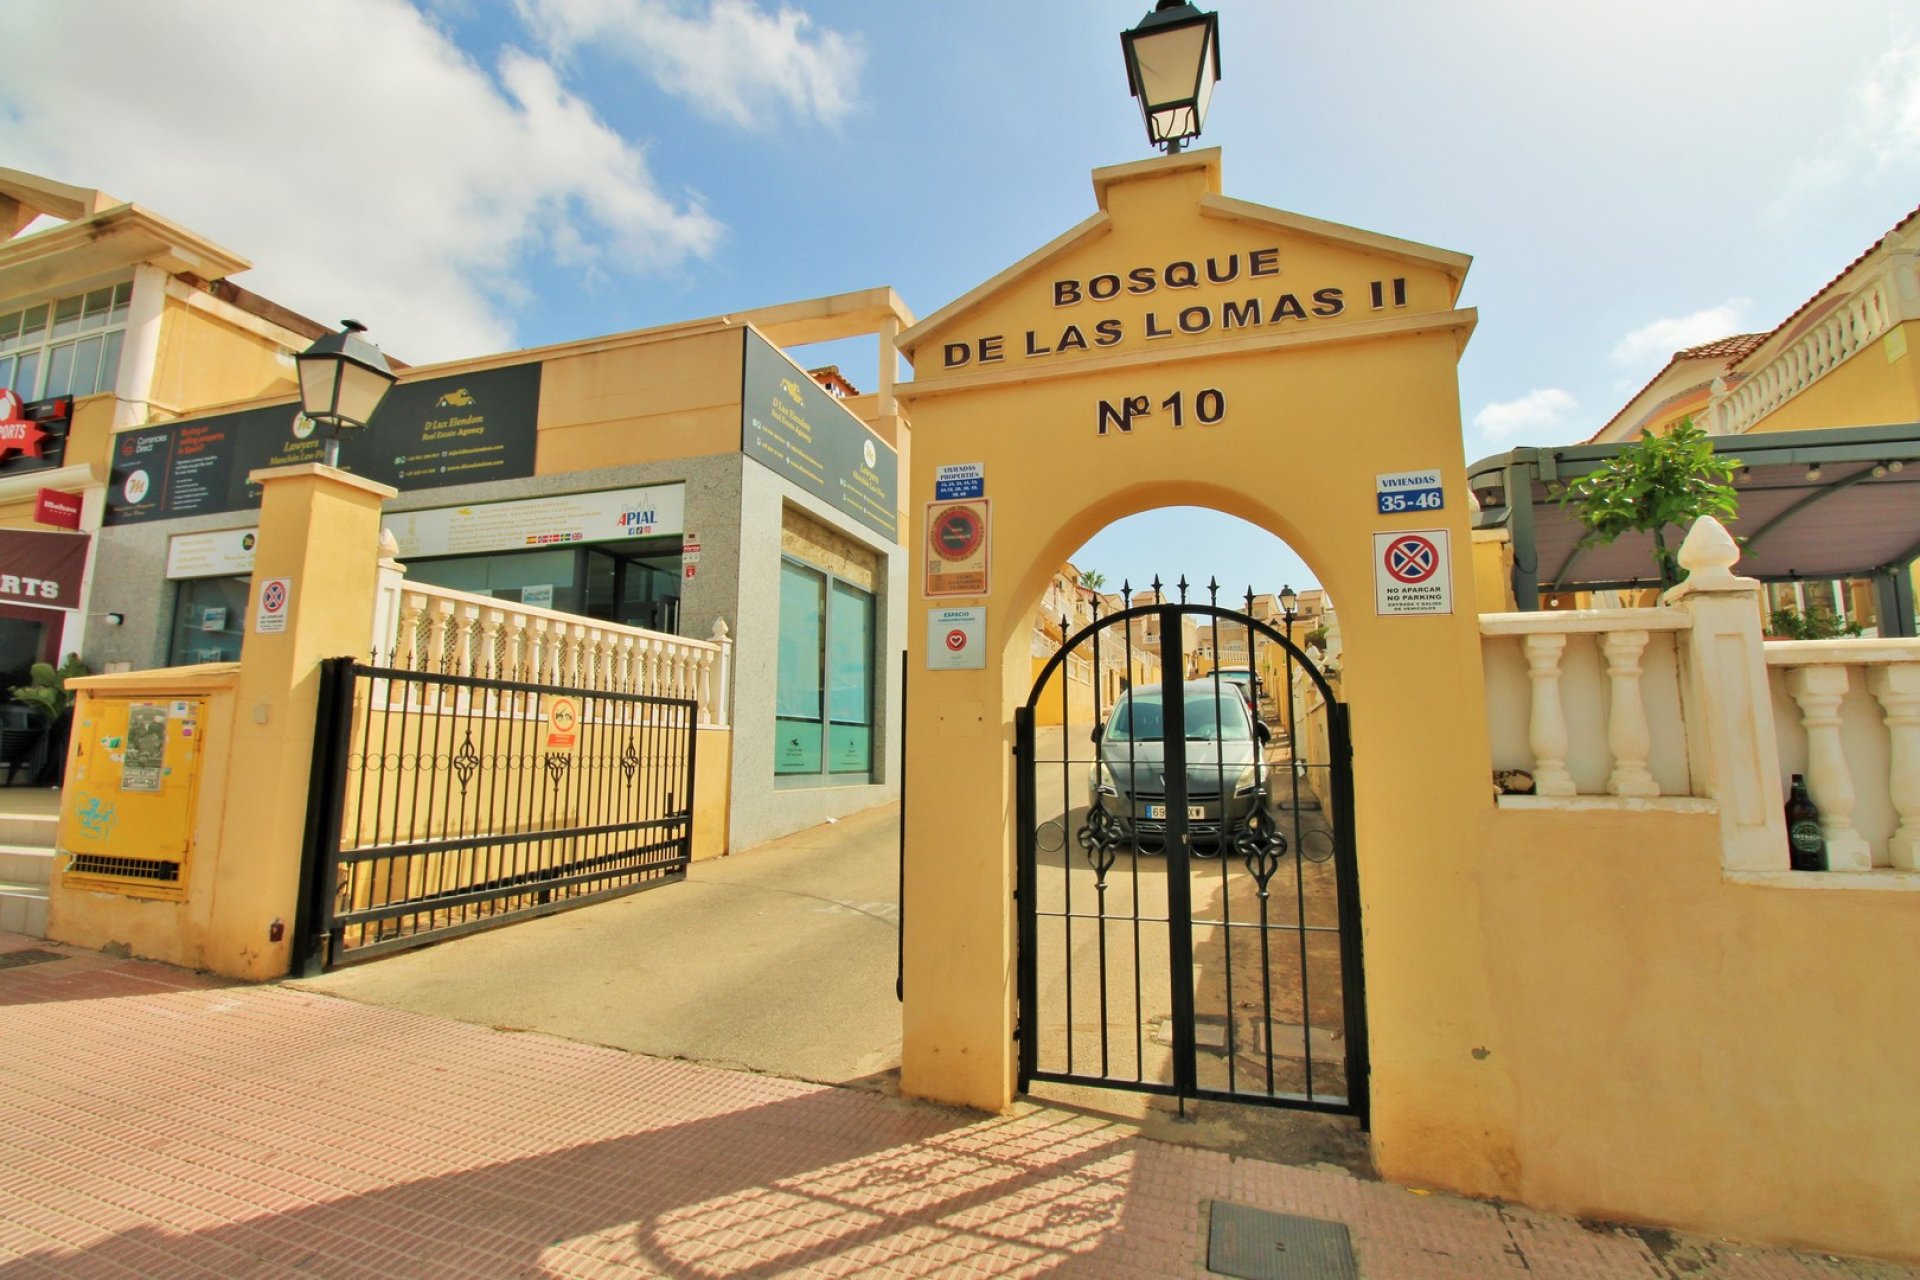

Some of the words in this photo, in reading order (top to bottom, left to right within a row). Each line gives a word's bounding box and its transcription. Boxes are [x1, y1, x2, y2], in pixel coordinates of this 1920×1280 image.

[1053, 247, 1281, 308] BOSQUE
[943, 334, 1006, 369] DE
[1024, 318, 1125, 358] LAS
[1144, 286, 1346, 341] LOMAS
[1369, 277, 1409, 311] II
[1382, 476, 1436, 488] VIVIENDAS
[617, 510, 658, 526] APIAL
